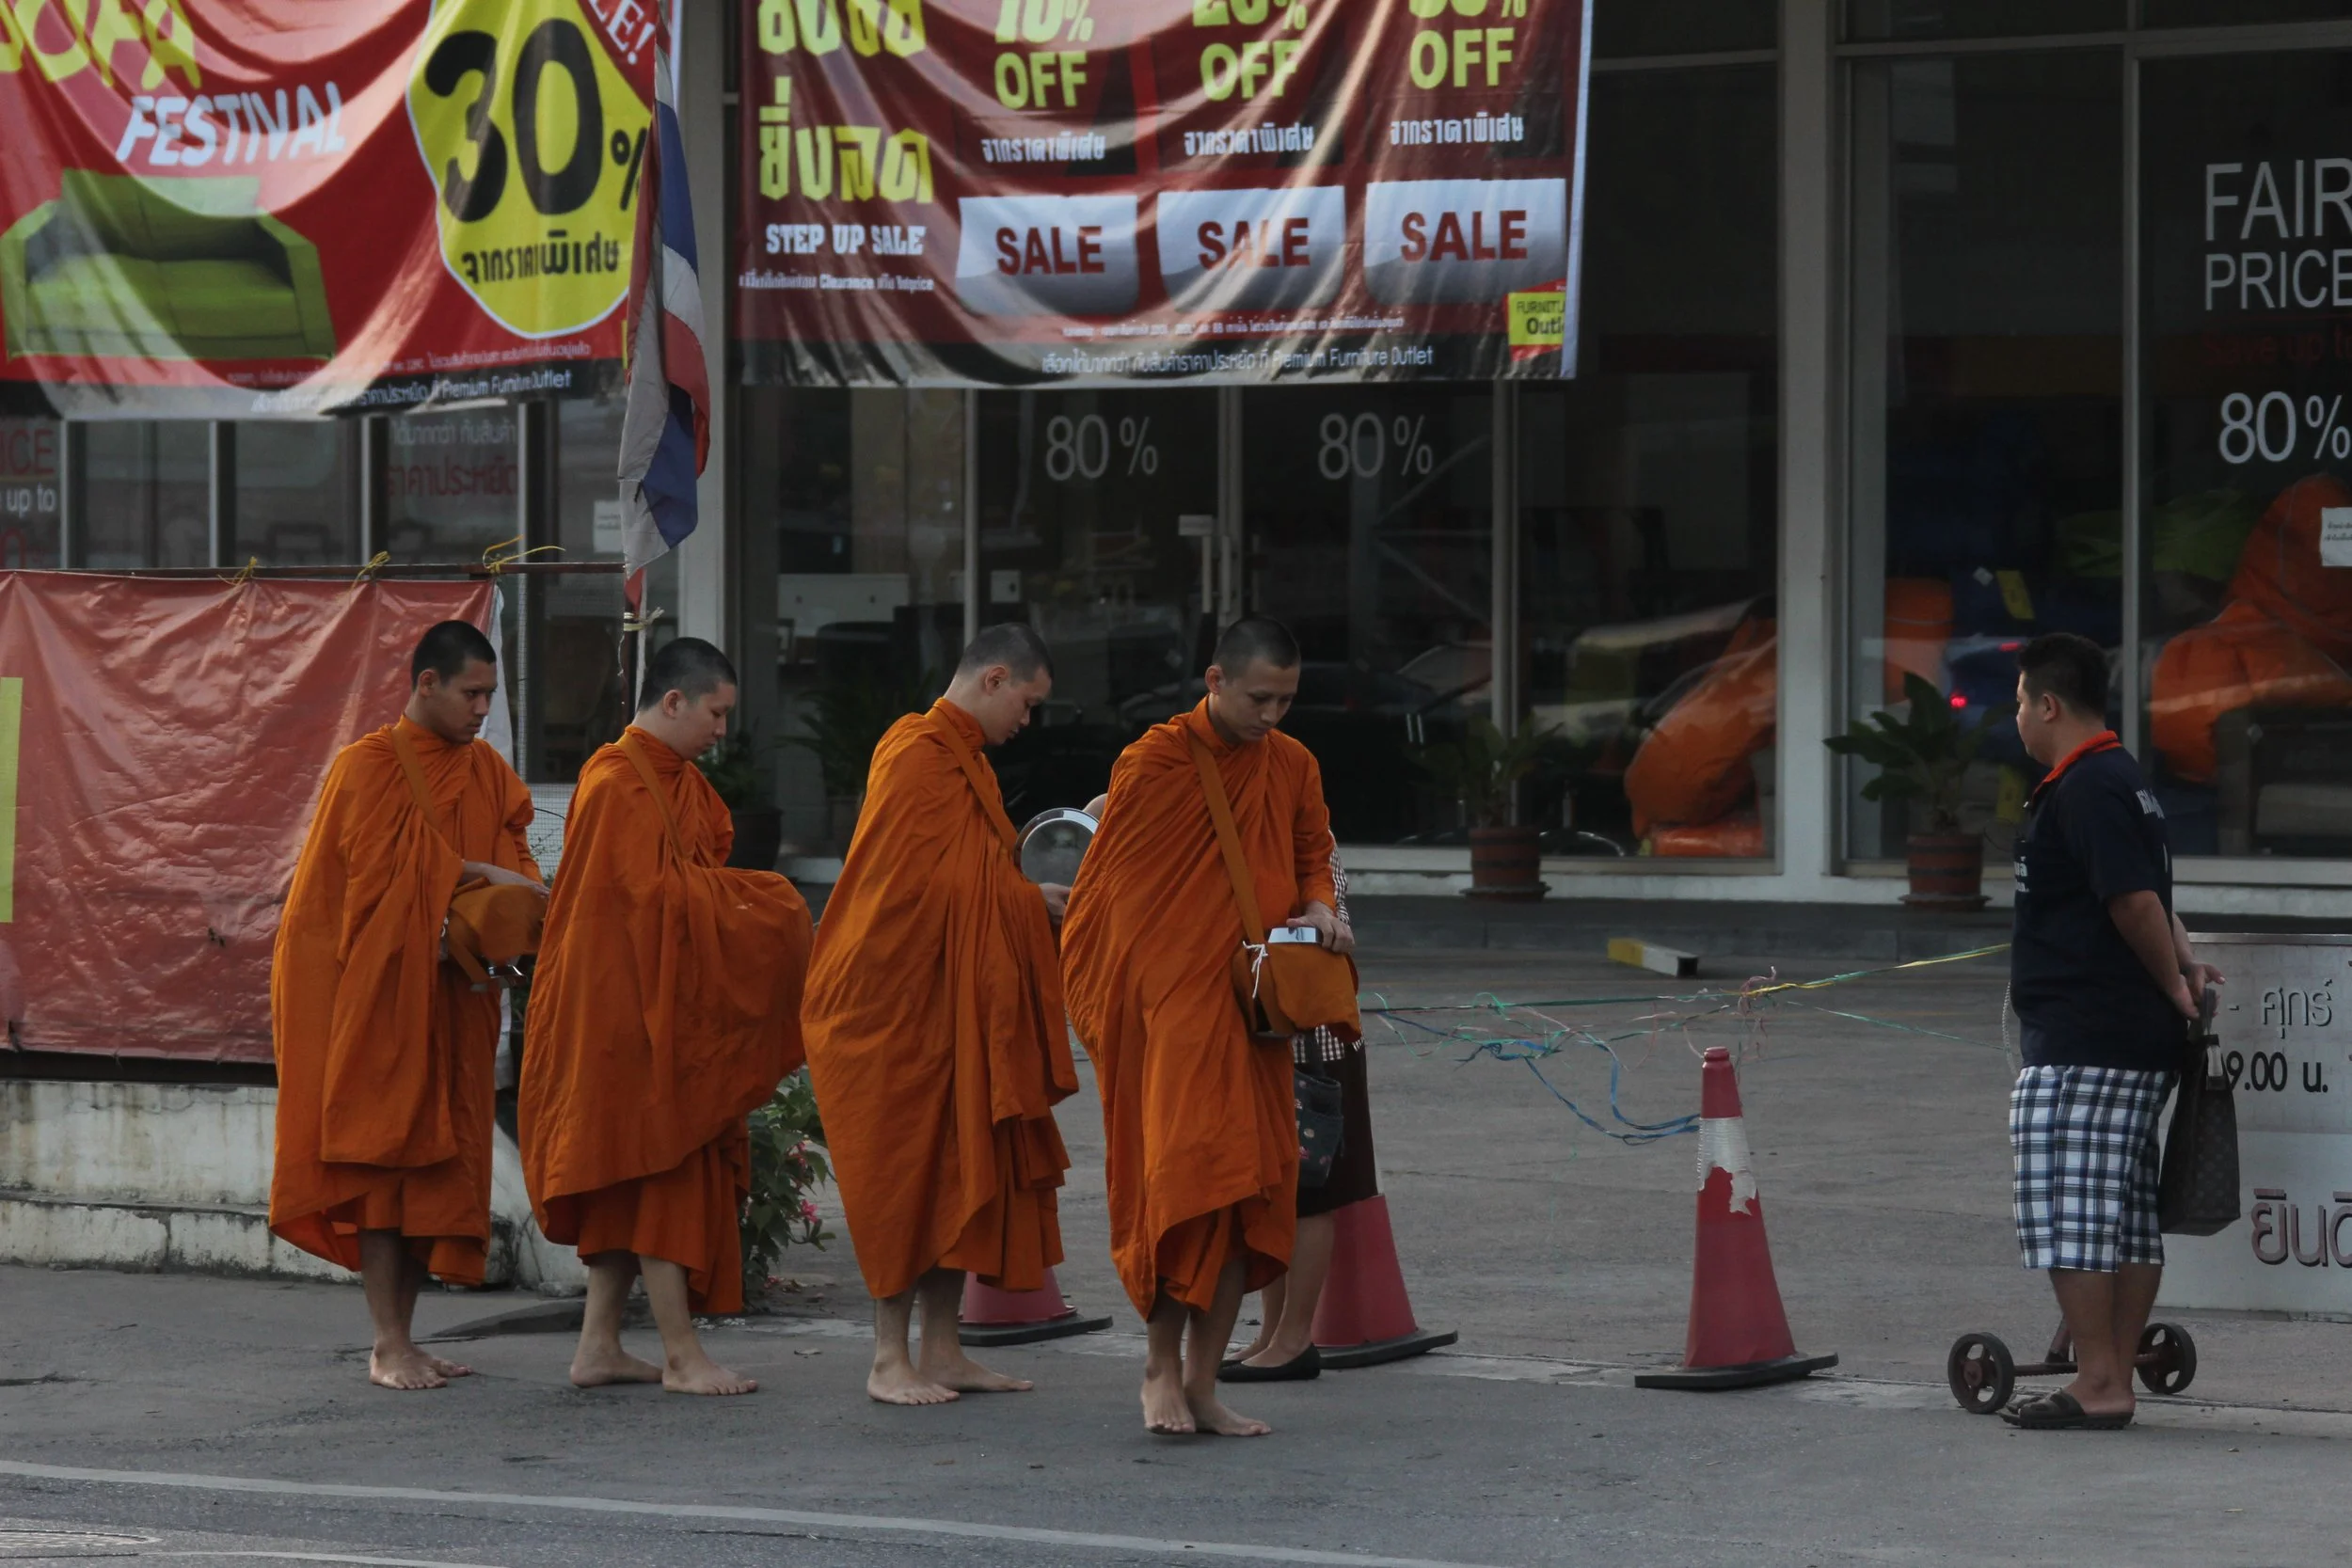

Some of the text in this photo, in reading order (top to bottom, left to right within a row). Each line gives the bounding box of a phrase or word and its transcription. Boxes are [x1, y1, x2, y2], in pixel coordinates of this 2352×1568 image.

[994, 50, 1088, 109] OFF
[1200, 39, 1302, 101] OFF
[1409, 27, 1515, 89] OFF
[115, 81, 346, 166] FESTIVAL
[1391, 111, 1524, 145] จากราคาพิเศษ
[2205, 157, 2352, 242] FAIR
[766, 224, 928, 255] STEP UP SALE
[995, 226, 1104, 276] SALE
[1197, 217, 1311, 270] SALE
[1400, 210, 1528, 262] SALE
[2205, 248, 2352, 310] PRICE
[1329, 347, 1388, 366] Furniture
[1391, 344, 1435, 365] Outlet
[1045, 414, 1158, 482] 80%
[1319, 412, 1433, 481] 80%
[2218, 391, 2352, 464] 80%
[6, 483, 57, 518] up to
